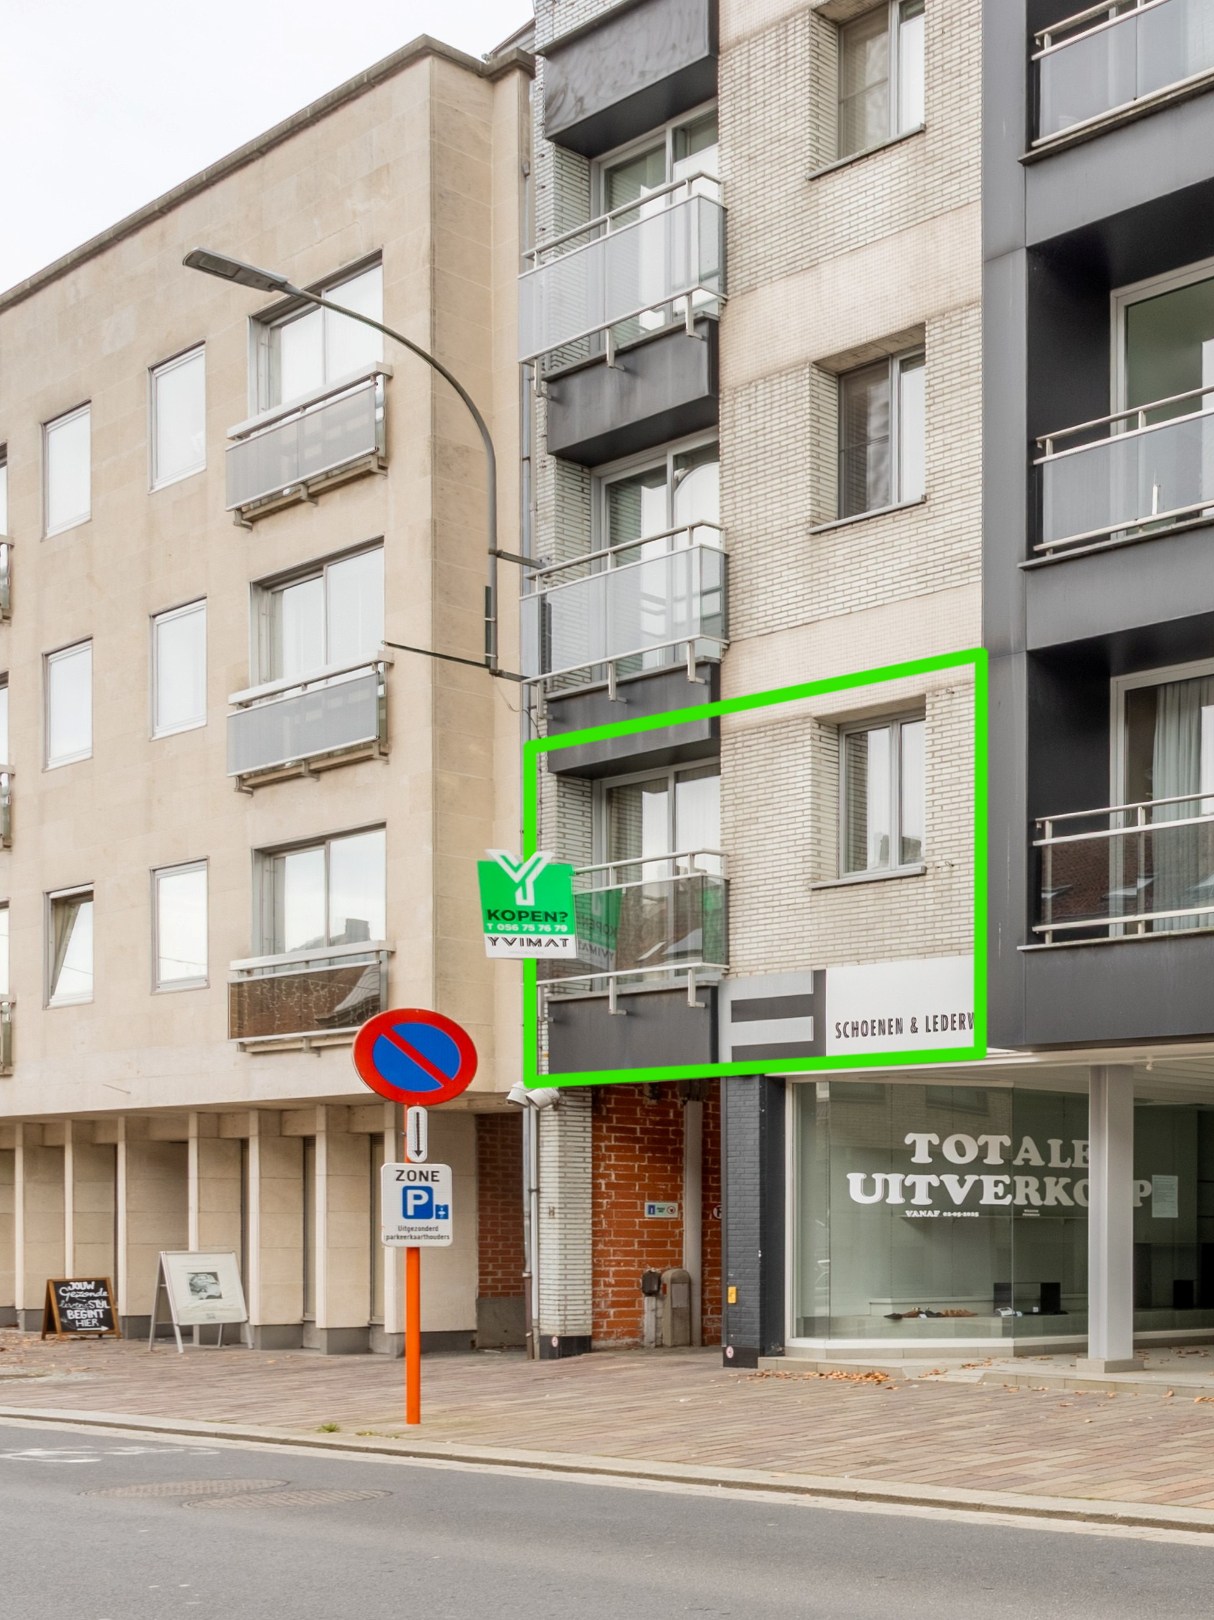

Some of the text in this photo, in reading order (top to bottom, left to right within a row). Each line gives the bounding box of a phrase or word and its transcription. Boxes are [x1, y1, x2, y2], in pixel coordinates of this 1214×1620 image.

[486, 909, 569, 923] KOPEN?
[486, 923, 494, 931] T
[497, 923, 519, 932] 056
[522, 924, 535, 932] 75
[487, 936, 570, 948] YVIMAT
[835, 1017, 904, 1039] SCHOENEN
[909, 1016, 919, 1034] &
[904, 1132, 1089, 1169] TOTALE
[395, 1169, 440, 1183] ZONE
[846, 1172, 1152, 1207] UITVERKOP
[905, 1210, 941, 1218] VANAF
[397, 1225, 439, 1234] Uitgezonderd
[385, 1233, 450, 1242] parkeerkaarthouders
[68, 1281, 95, 1291] JOUW
[66, 1309, 104, 1320] BEGINT
[75, 1318, 100, 1327] HIER
